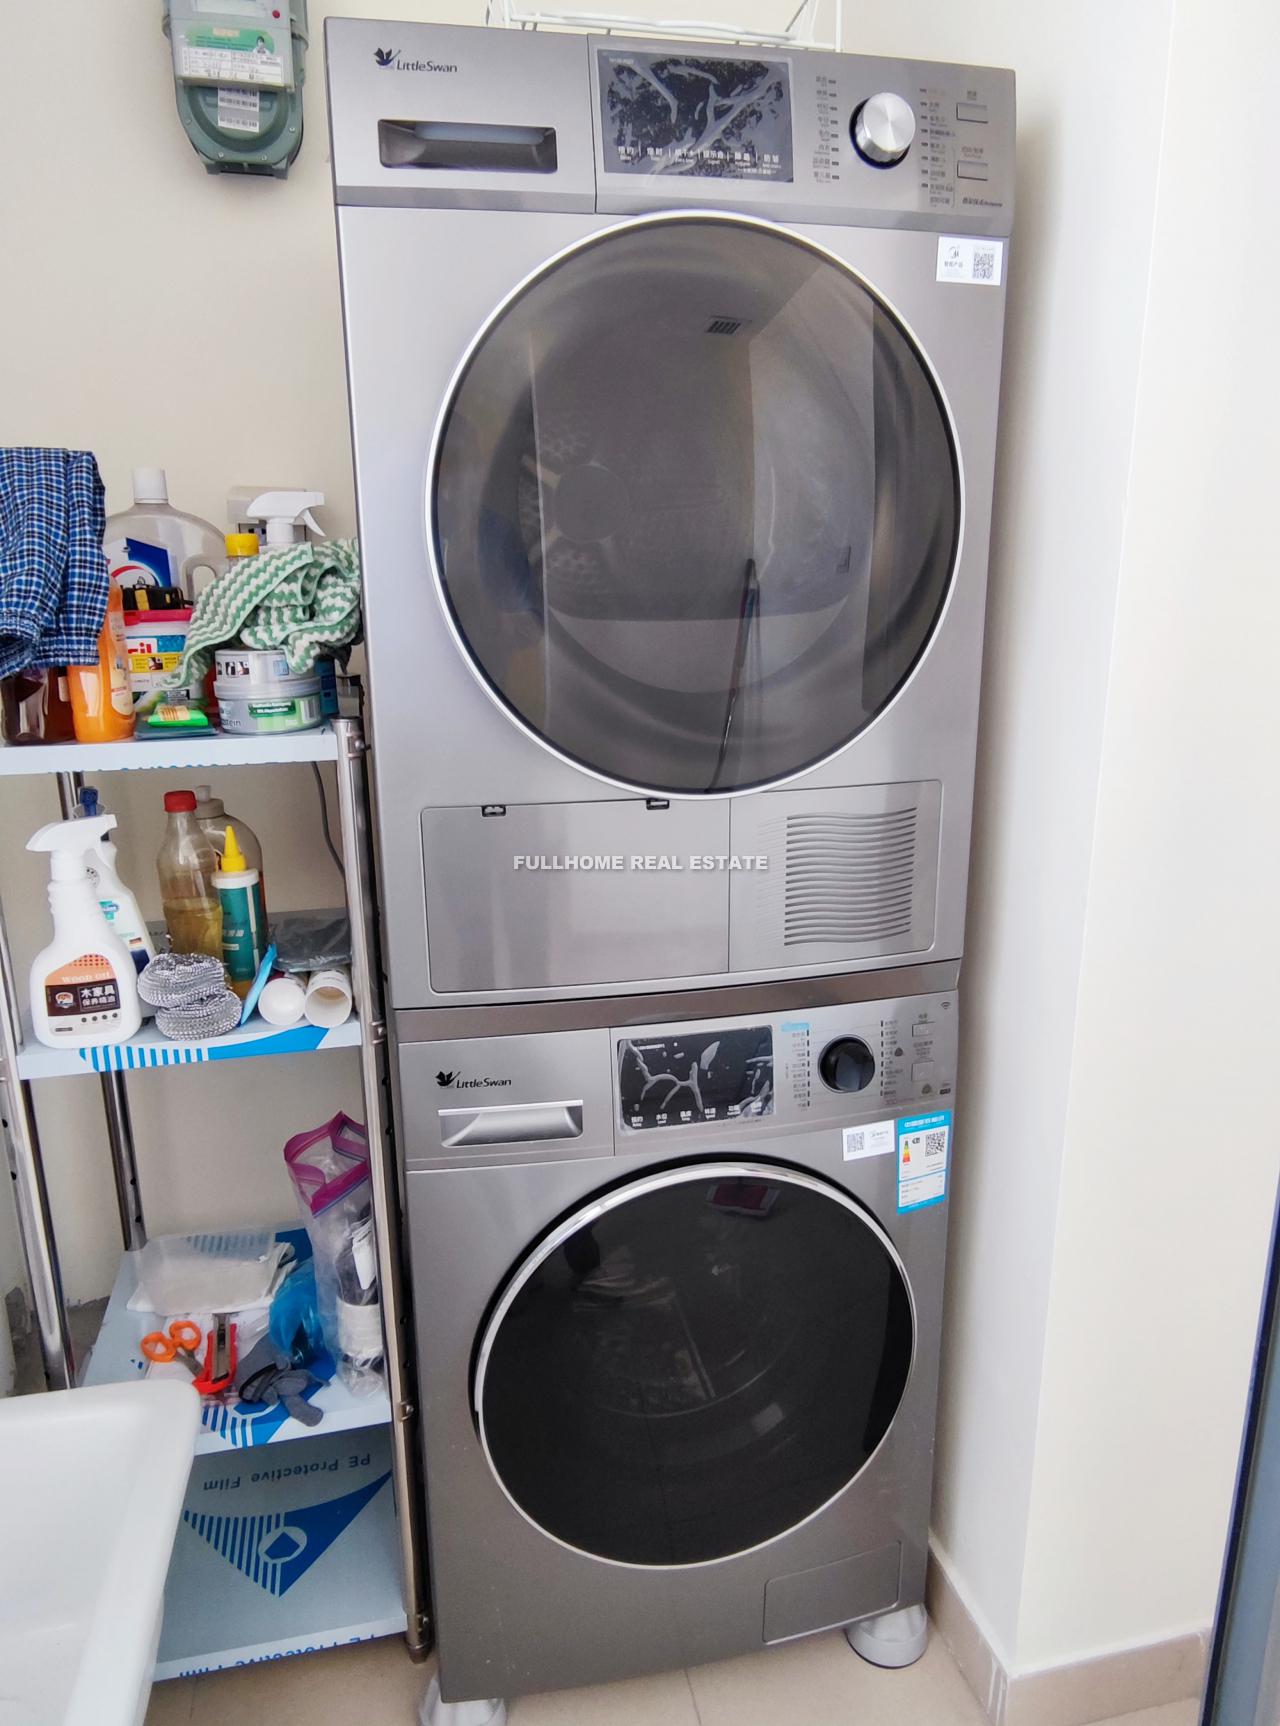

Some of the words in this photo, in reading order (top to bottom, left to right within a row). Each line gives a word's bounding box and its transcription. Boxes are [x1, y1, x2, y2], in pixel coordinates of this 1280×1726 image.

[397, 60, 458, 73] LittleSwan
[456, 1077, 512, 1089] LittleSwan
[349, 1453, 371, 1468] PE
[250, 1459, 339, 1482] Protective
[202, 1476, 241, 1491] Film
